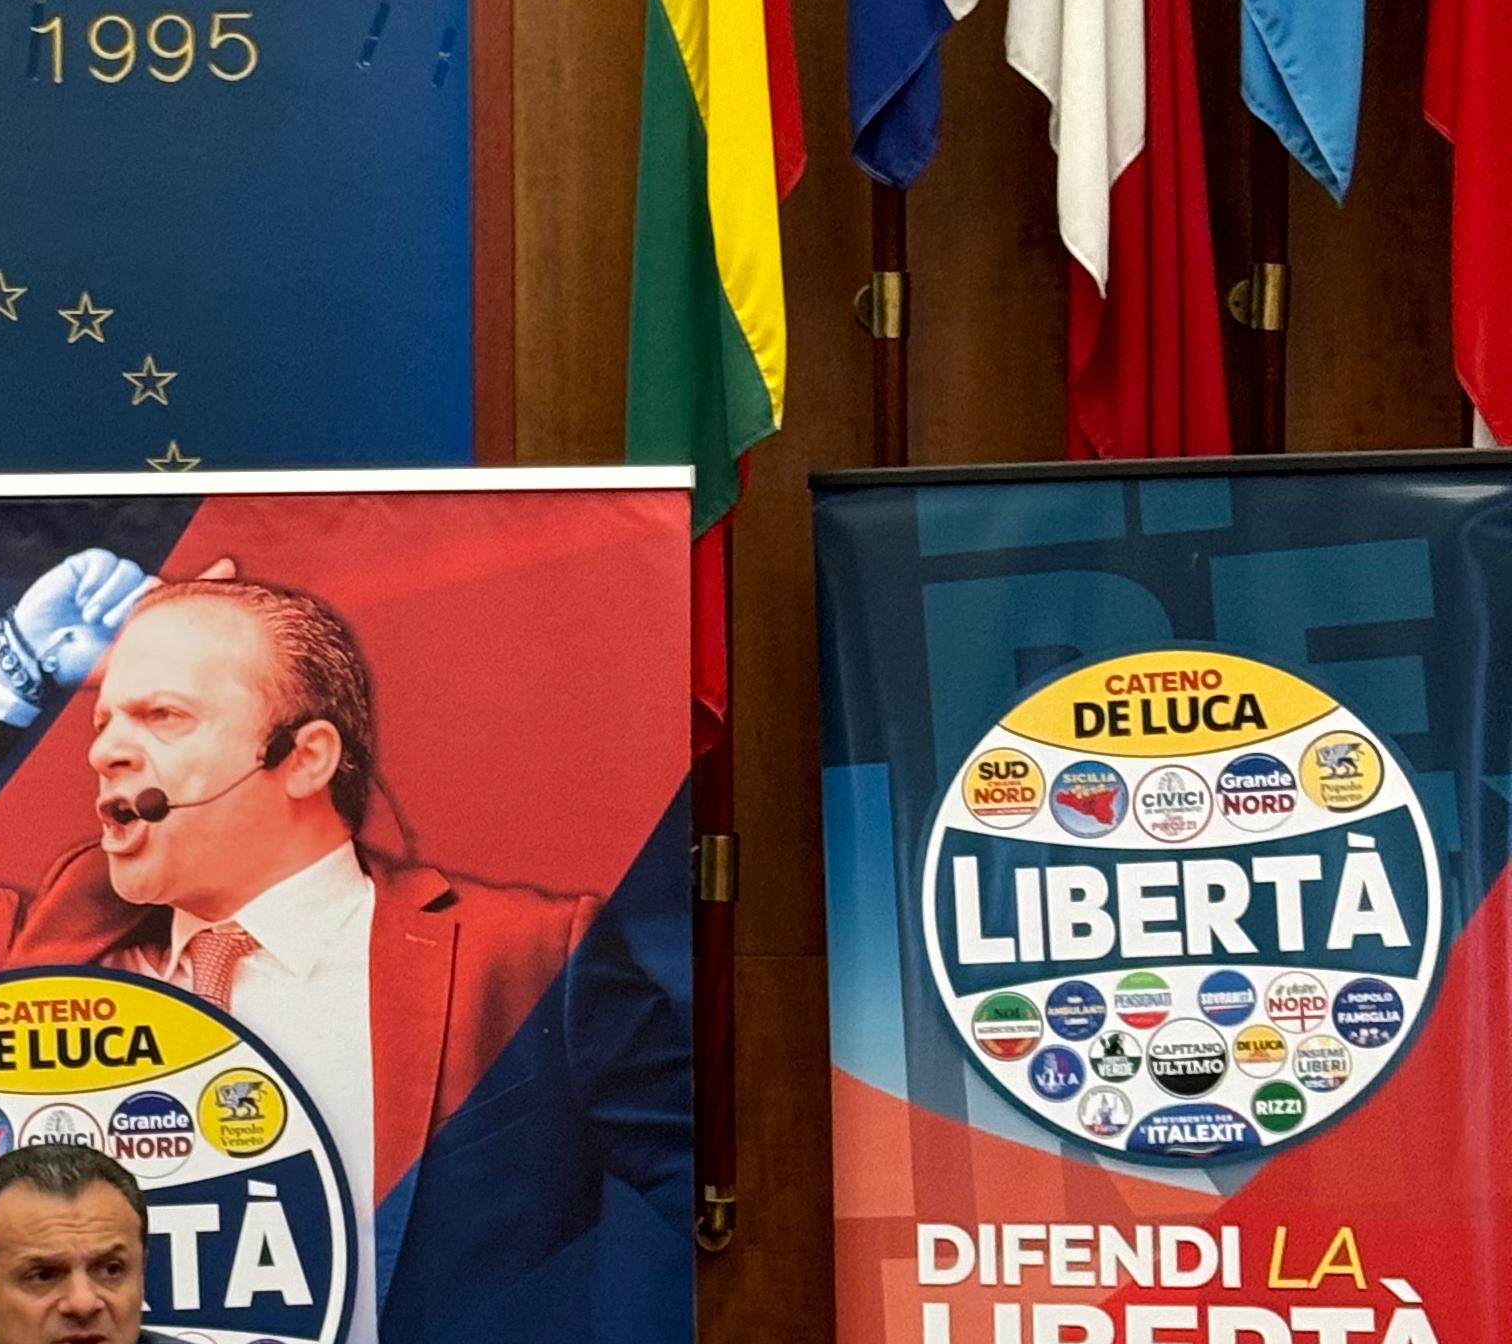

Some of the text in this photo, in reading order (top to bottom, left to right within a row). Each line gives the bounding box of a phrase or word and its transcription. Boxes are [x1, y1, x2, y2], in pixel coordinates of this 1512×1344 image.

[35, 9, 261, 85] 1995
[1105, 668, 1223, 697] CATENO
[1073, 693, 1268, 741] DE LUCA
[978, 761, 1029, 781] SUD
[1062, 772, 1117, 784] SICILIA
[1220, 770, 1293, 790] Grande
[974, 786, 1036, 805] NORD
[1141, 790, 1205, 808] CIVICI
[1222, 793, 1296, 817] NORD
[952, 831, 1412, 966] LIBERTÀ
[1269, 996, 1326, 1013] NORD
[1348, 992, 1394, 1003] POPOLO
[1337, 1010, 1401, 1024] FAMIGLIA
[27, 1025, 165, 1071] LUCA
[1152, 1042, 1224, 1056] CAPITANO
[1237, 1040, 1284, 1052] DE LUCA
[1152, 1059, 1224, 1076] ULTIMO
[1298, 1059, 1346, 1073] LIBERI
[1255, 1099, 1302, 1115] RIZZI
[112, 1110, 190, 1132] Grande
[219, 1124, 265, 1136] Popolo
[27, 1133, 96, 1148] CIVICI
[115, 1134, 193, 1160] NORD
[219, 1135, 265, 1148] Veneto
[916, 1222, 1368, 1290] DIFENDI LA
